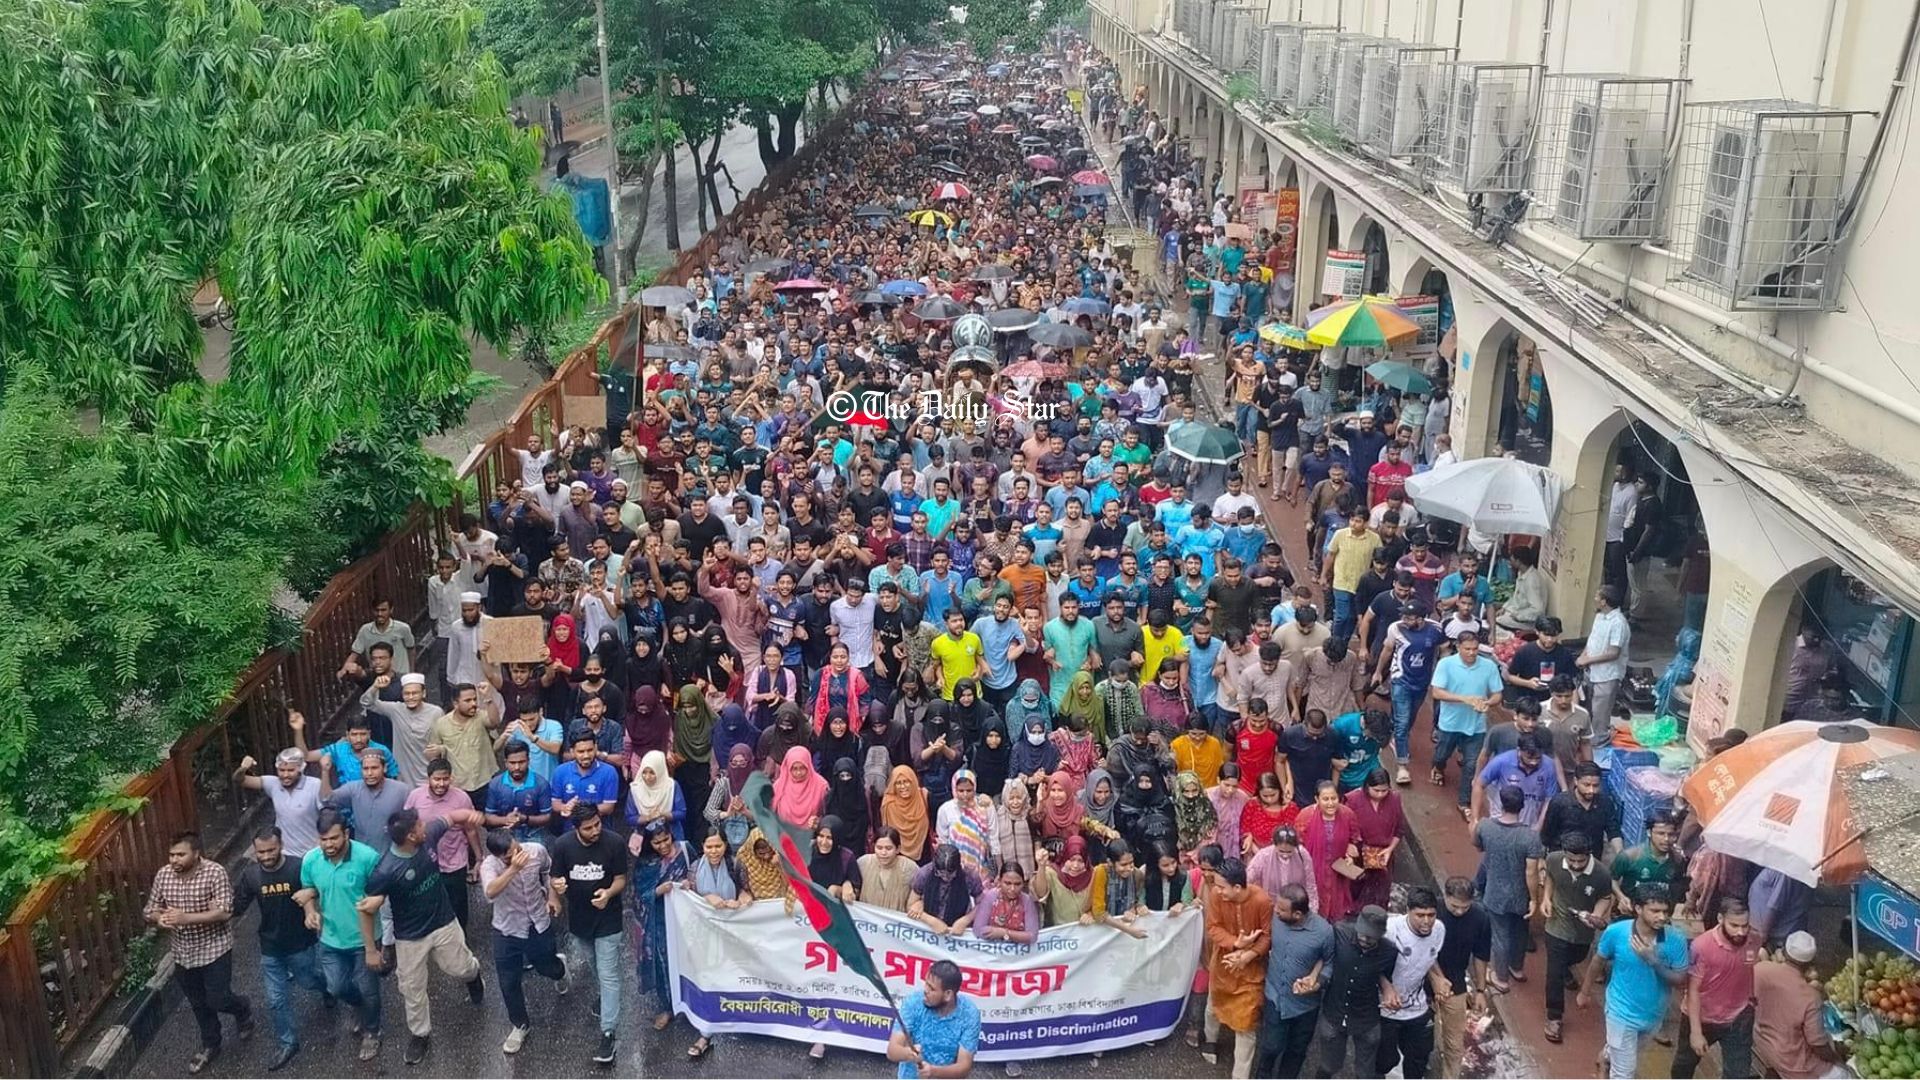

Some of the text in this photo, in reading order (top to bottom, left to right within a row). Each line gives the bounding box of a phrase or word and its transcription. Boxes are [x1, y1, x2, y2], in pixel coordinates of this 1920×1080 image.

[884, 921, 940, 946] পরিপত্র
[1037, 935, 1080, 951] দাবিতে
[719, 996, 893, 1030] বৈষম্যবিরোধী ছাত্র আন্দোলন
[978, 1014, 1138, 1044] Against Discrimination
